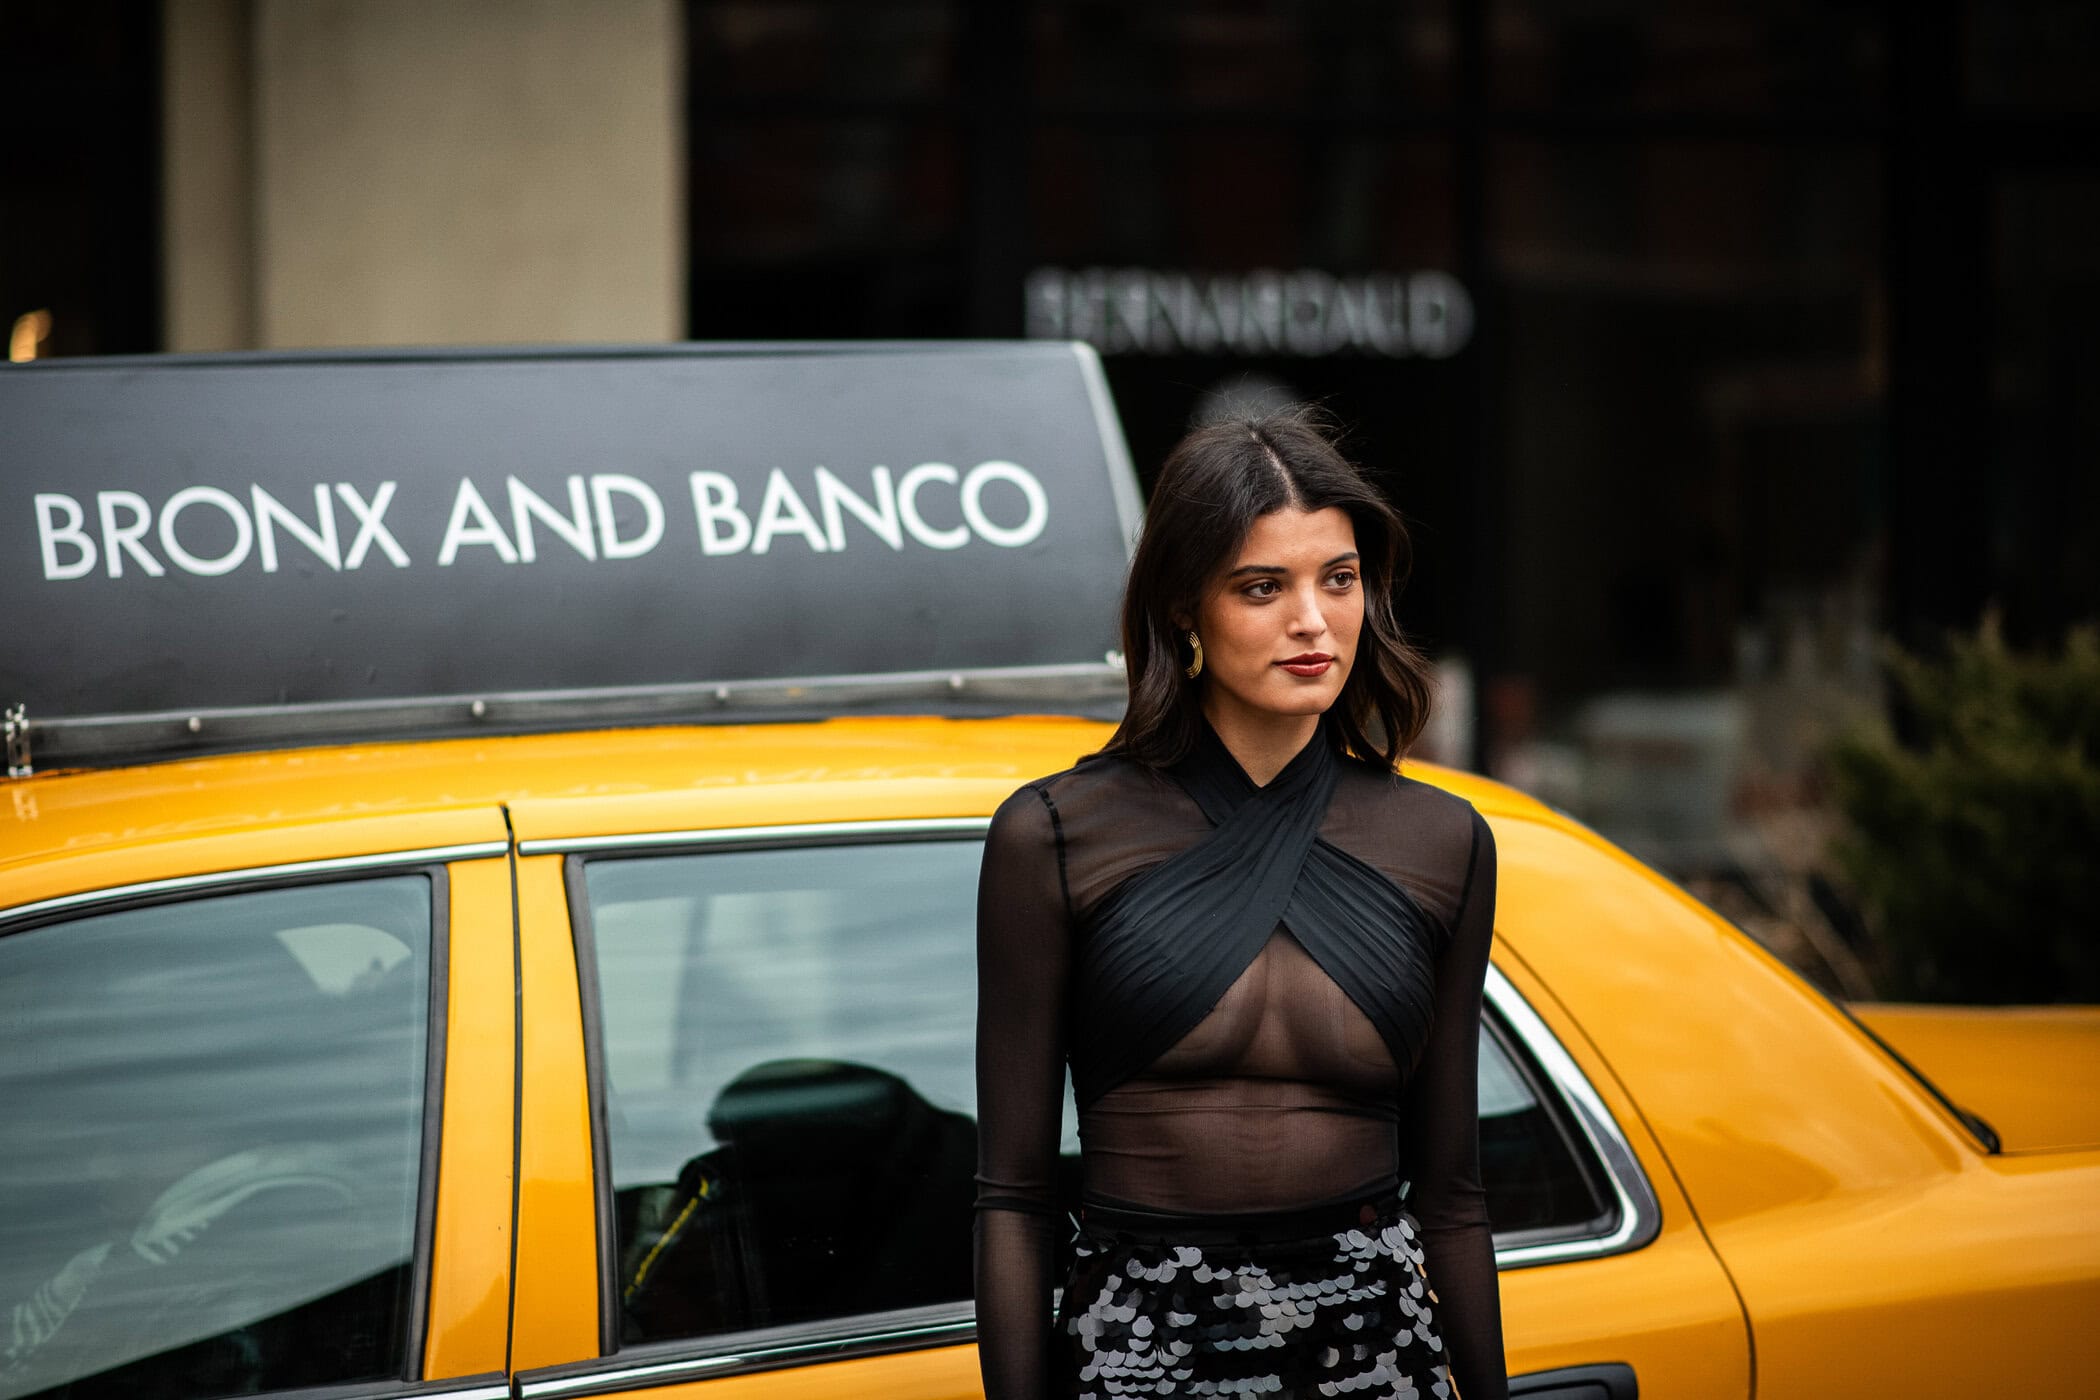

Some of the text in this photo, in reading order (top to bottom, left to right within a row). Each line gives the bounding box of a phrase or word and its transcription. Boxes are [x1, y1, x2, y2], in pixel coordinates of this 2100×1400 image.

[33, 459, 1049, 580] BRONX AND BANCO
